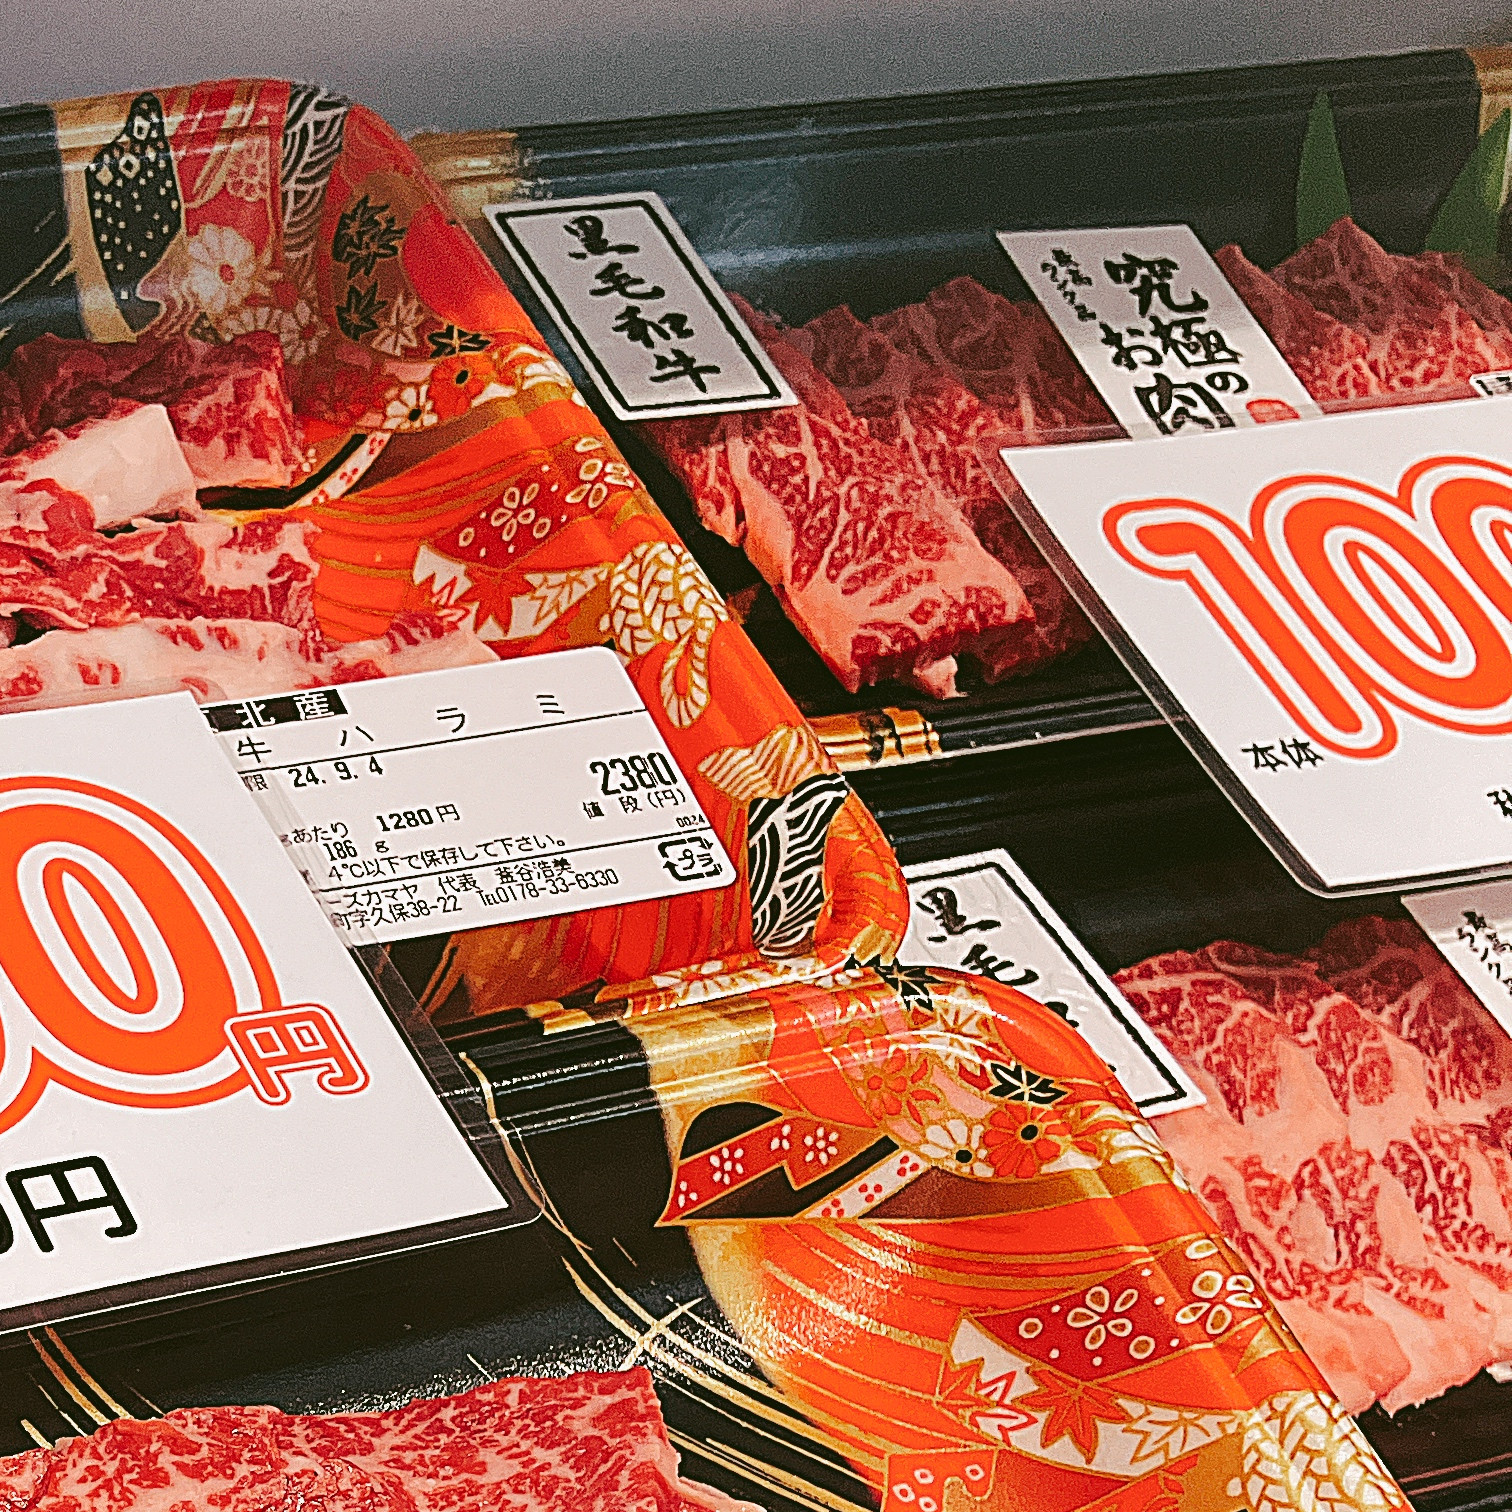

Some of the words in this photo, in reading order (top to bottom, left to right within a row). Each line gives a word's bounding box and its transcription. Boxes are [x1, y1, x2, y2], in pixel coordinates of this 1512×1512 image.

[563, 215, 721, 394] 黒毛和牛
[200, 691, 336, 733] 北産
[589, 752, 678, 795] 2380
[1241, 736, 1324, 772] 本体
[323, 840, 358, 861] 186
[438, 872, 480, 896] 代表
